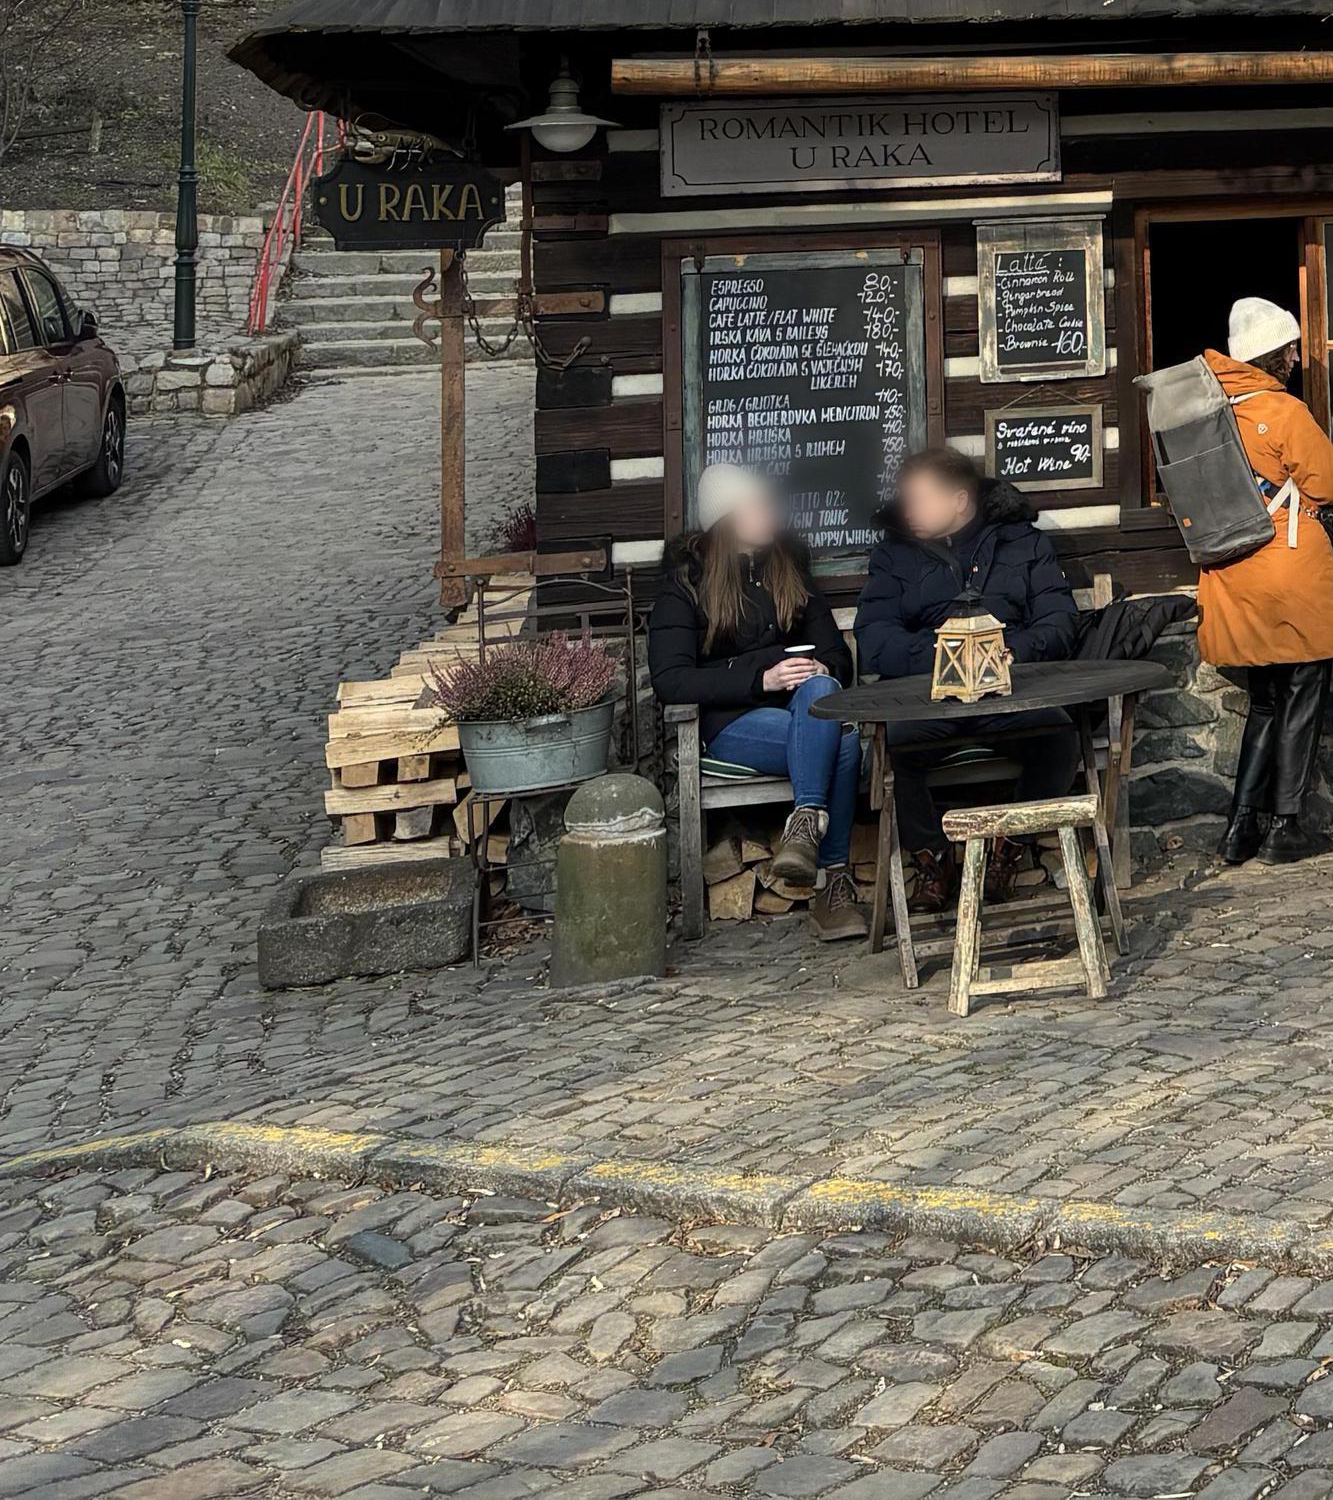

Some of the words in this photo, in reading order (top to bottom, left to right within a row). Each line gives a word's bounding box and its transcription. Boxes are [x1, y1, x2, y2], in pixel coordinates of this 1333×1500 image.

[699, 114, 890, 141] ROMANTIK
[903, 110, 1030, 136] HOTEL
[791, 147, 817, 170] U
[832, 143, 934, 169] RAKA
[338, 183, 365, 222] U
[377, 182, 485, 222] RAKA
[710, 278, 764, 295] ESPRESSO
[863, 273, 898, 293] 80,-
[1052, 269, 1075, 283] Roll
[709, 295, 768, 312] CAPUCCINO
[802, 308, 837, 323] WHITE
[863, 306, 900, 323] 140,-
[709, 327, 742, 345] IRSKÁ
[745, 326, 771, 343] KÁVA
[786, 325, 829, 340] BAILEYS
[863, 322, 899, 340] 180,-
[709, 344, 747, 365] HORKÁ
[801, 343, 813, 358] SE
[875, 341, 903, 359] 140,-
[708, 363, 745, 381] HORKÁ
[801, 361, 809, 376] S
[875, 360, 904, 380] 170,-
[707, 412, 745, 429] HORKÁ
[747, 408, 817, 427] BECHEROVKA
[996, 420, 1056, 438] Svařené
[707, 428, 745, 447] HORKÁ
[748, 426, 792, 445] HRUŠKA
[706, 446, 743, 466] HORKÁ
[747, 444, 792, 462] HRUŠKA
[795, 443, 802, 458] S
[1000, 457, 1033, 476] Hot
[1037, 457, 1073, 473] Wine
[817, 509, 849, 527] TONIC
[799, 528, 885, 548] RAPPY/WHISKY
